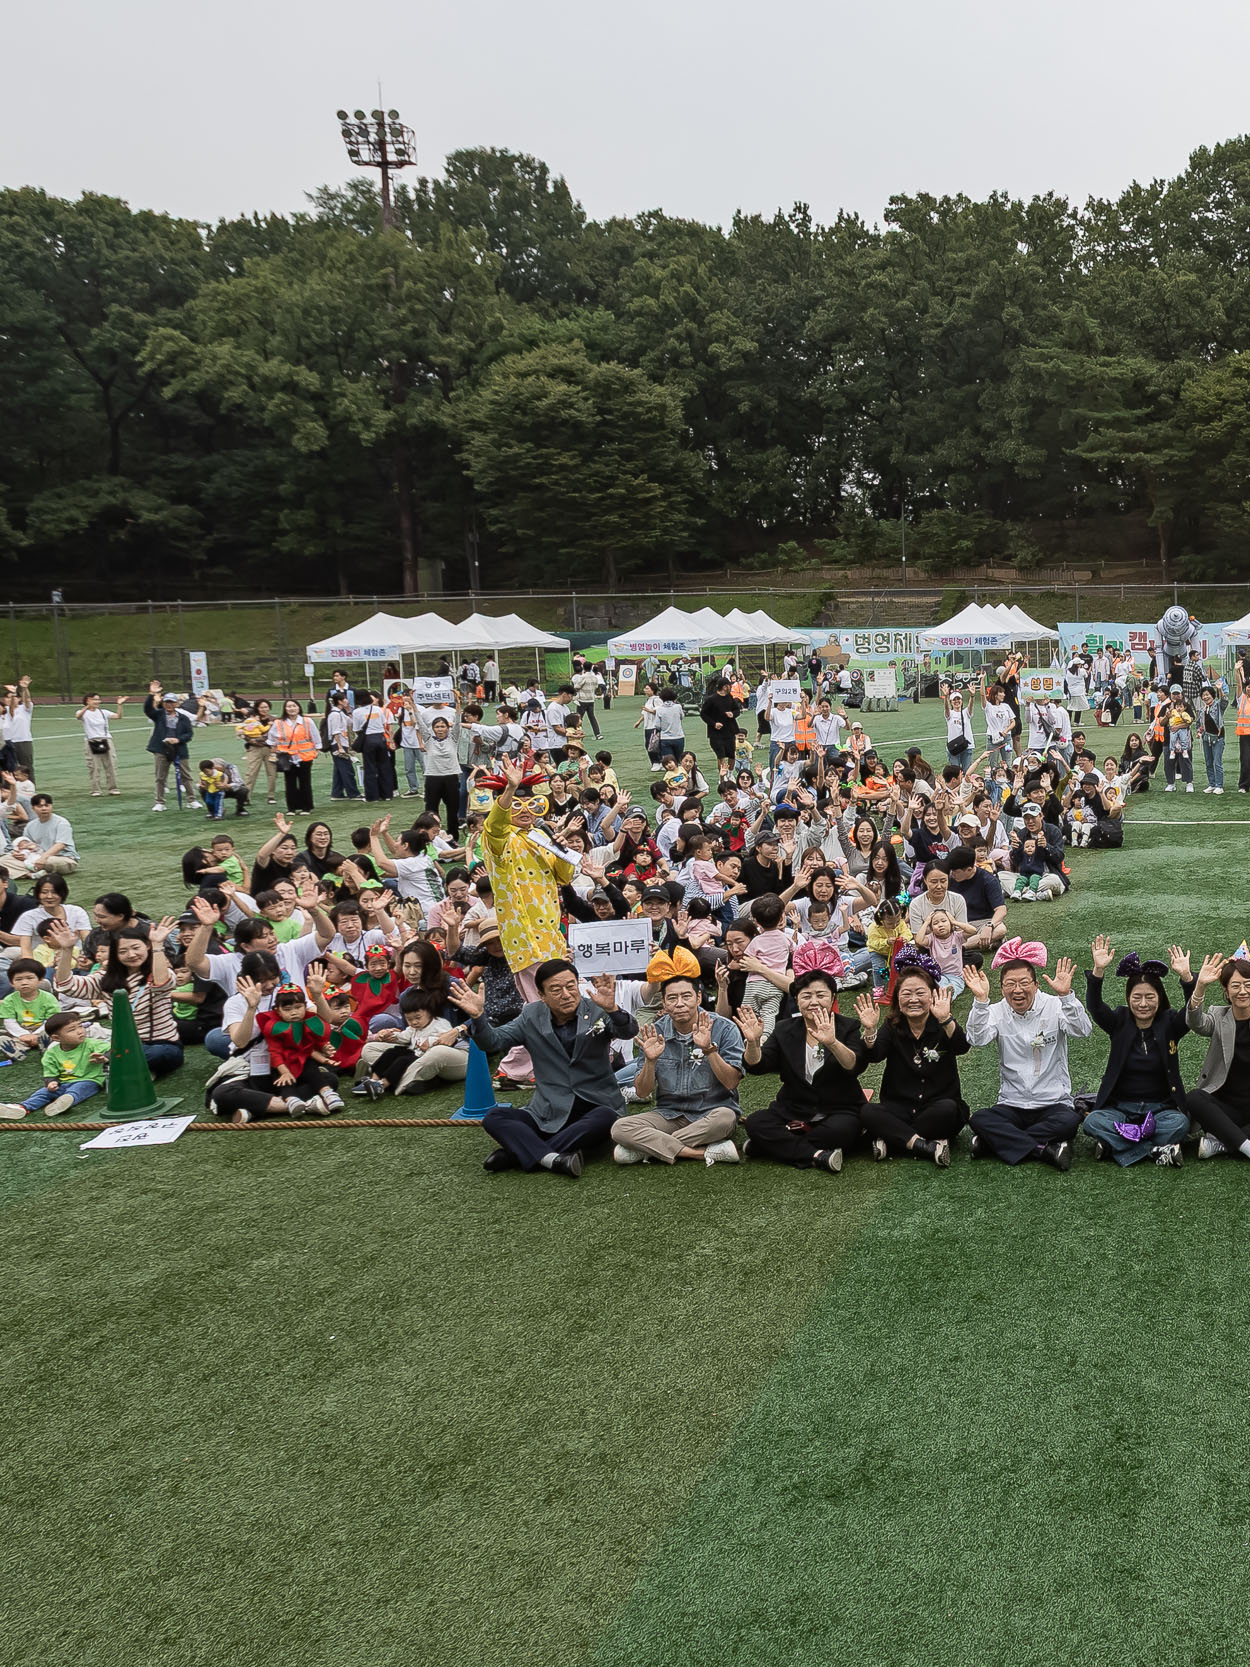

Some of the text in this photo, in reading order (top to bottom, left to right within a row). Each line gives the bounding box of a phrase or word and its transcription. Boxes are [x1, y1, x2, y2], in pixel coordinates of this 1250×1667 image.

[941, 637, 998, 645] 캠핑놀이 체험존
[629, 642, 686, 651] 병영놀이 체험존
[330, 648, 386, 657] 전통놀이 체험존
[416, 692, 451, 700] 주민센터
[577, 940, 646, 958] 행복마루
